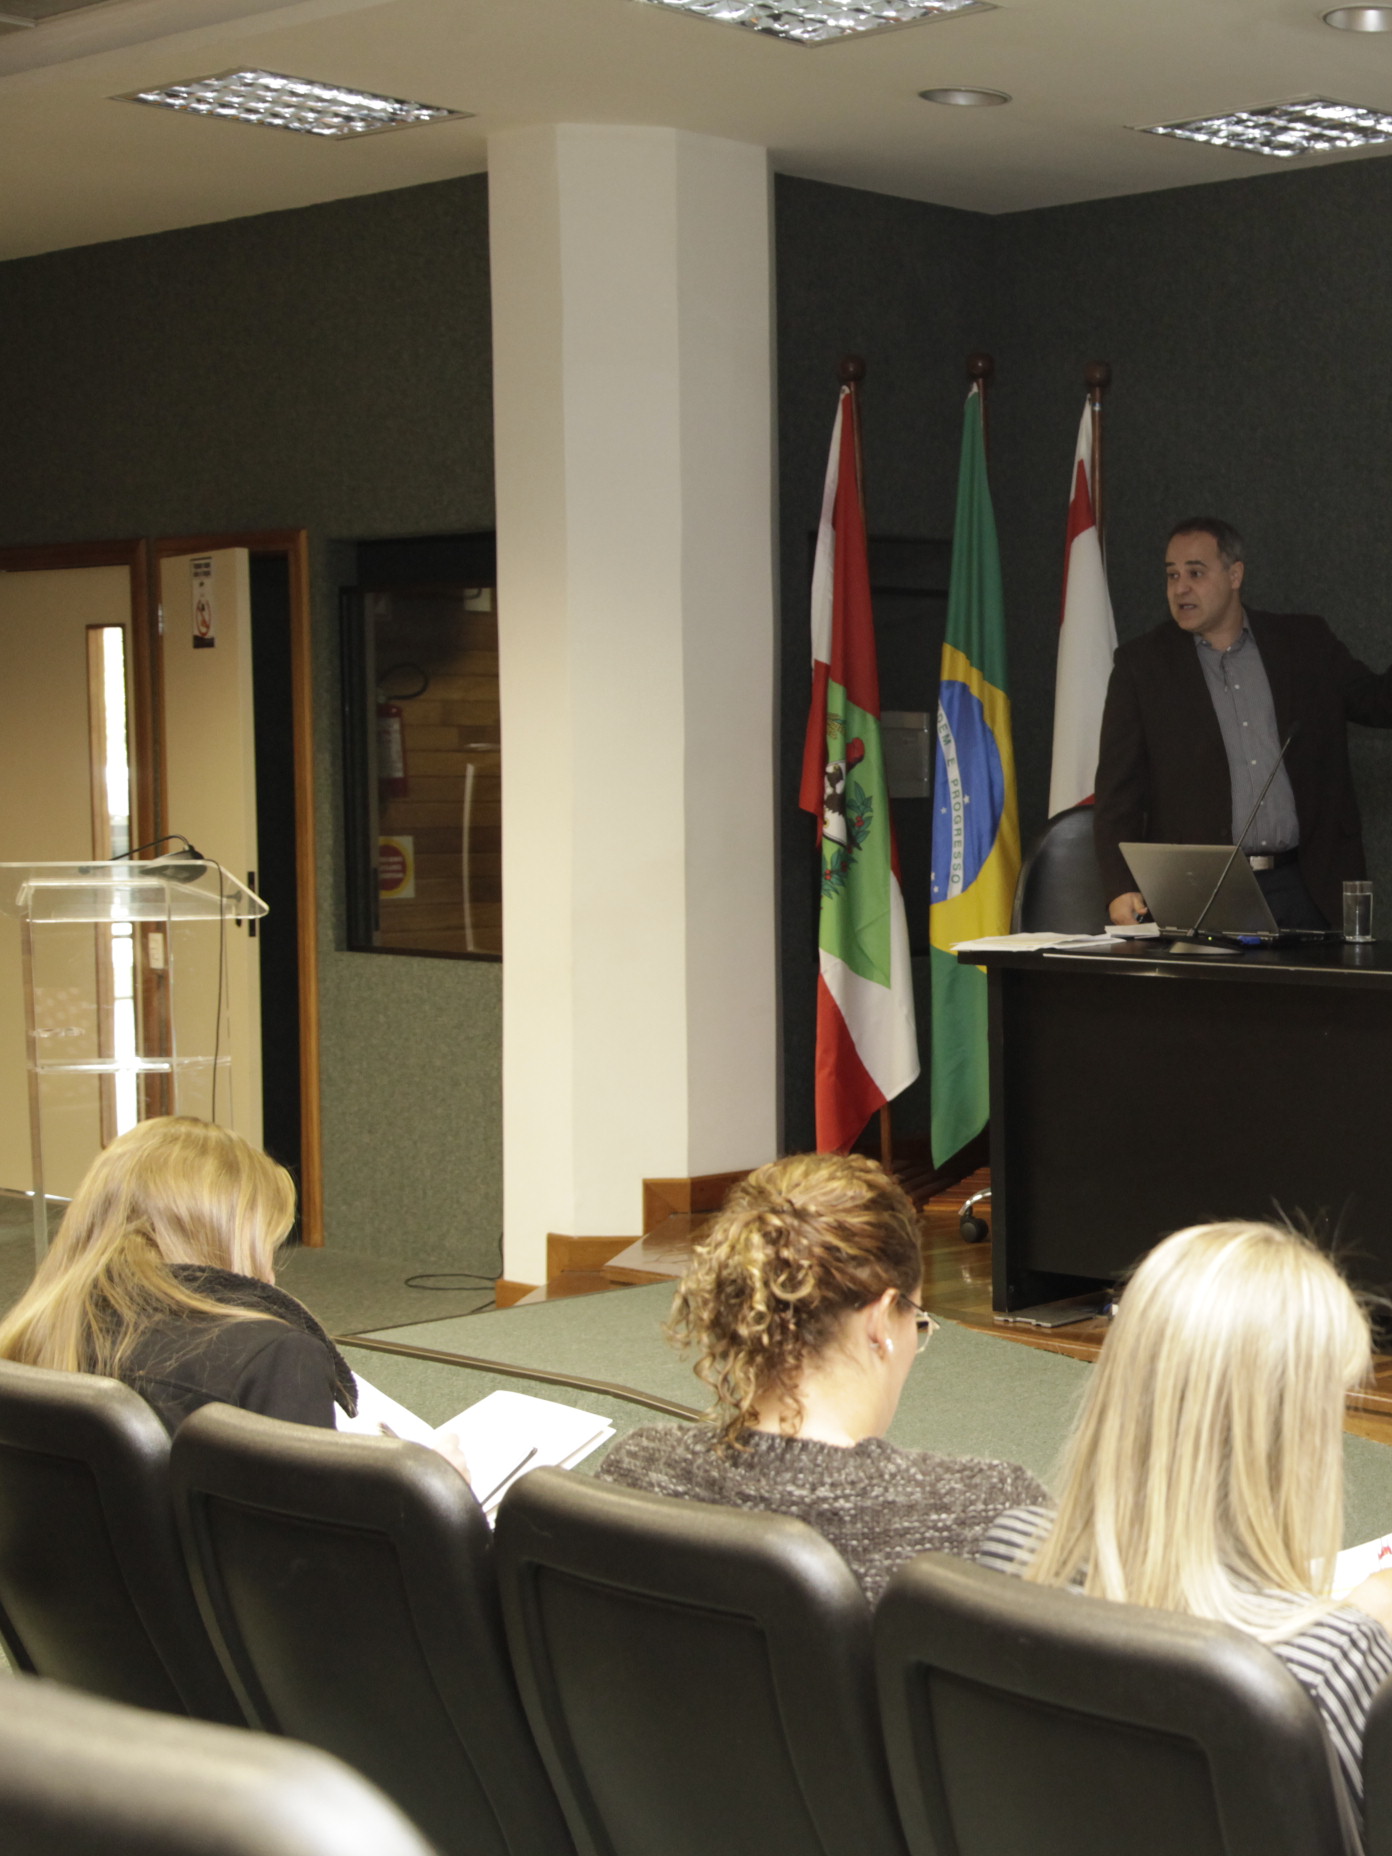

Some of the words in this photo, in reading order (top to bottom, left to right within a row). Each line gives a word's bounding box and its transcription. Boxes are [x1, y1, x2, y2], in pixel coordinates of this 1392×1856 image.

[937, 708, 952, 746] DEM
[946, 757, 955, 767] E
[950, 777, 963, 885] PROGRESSO
